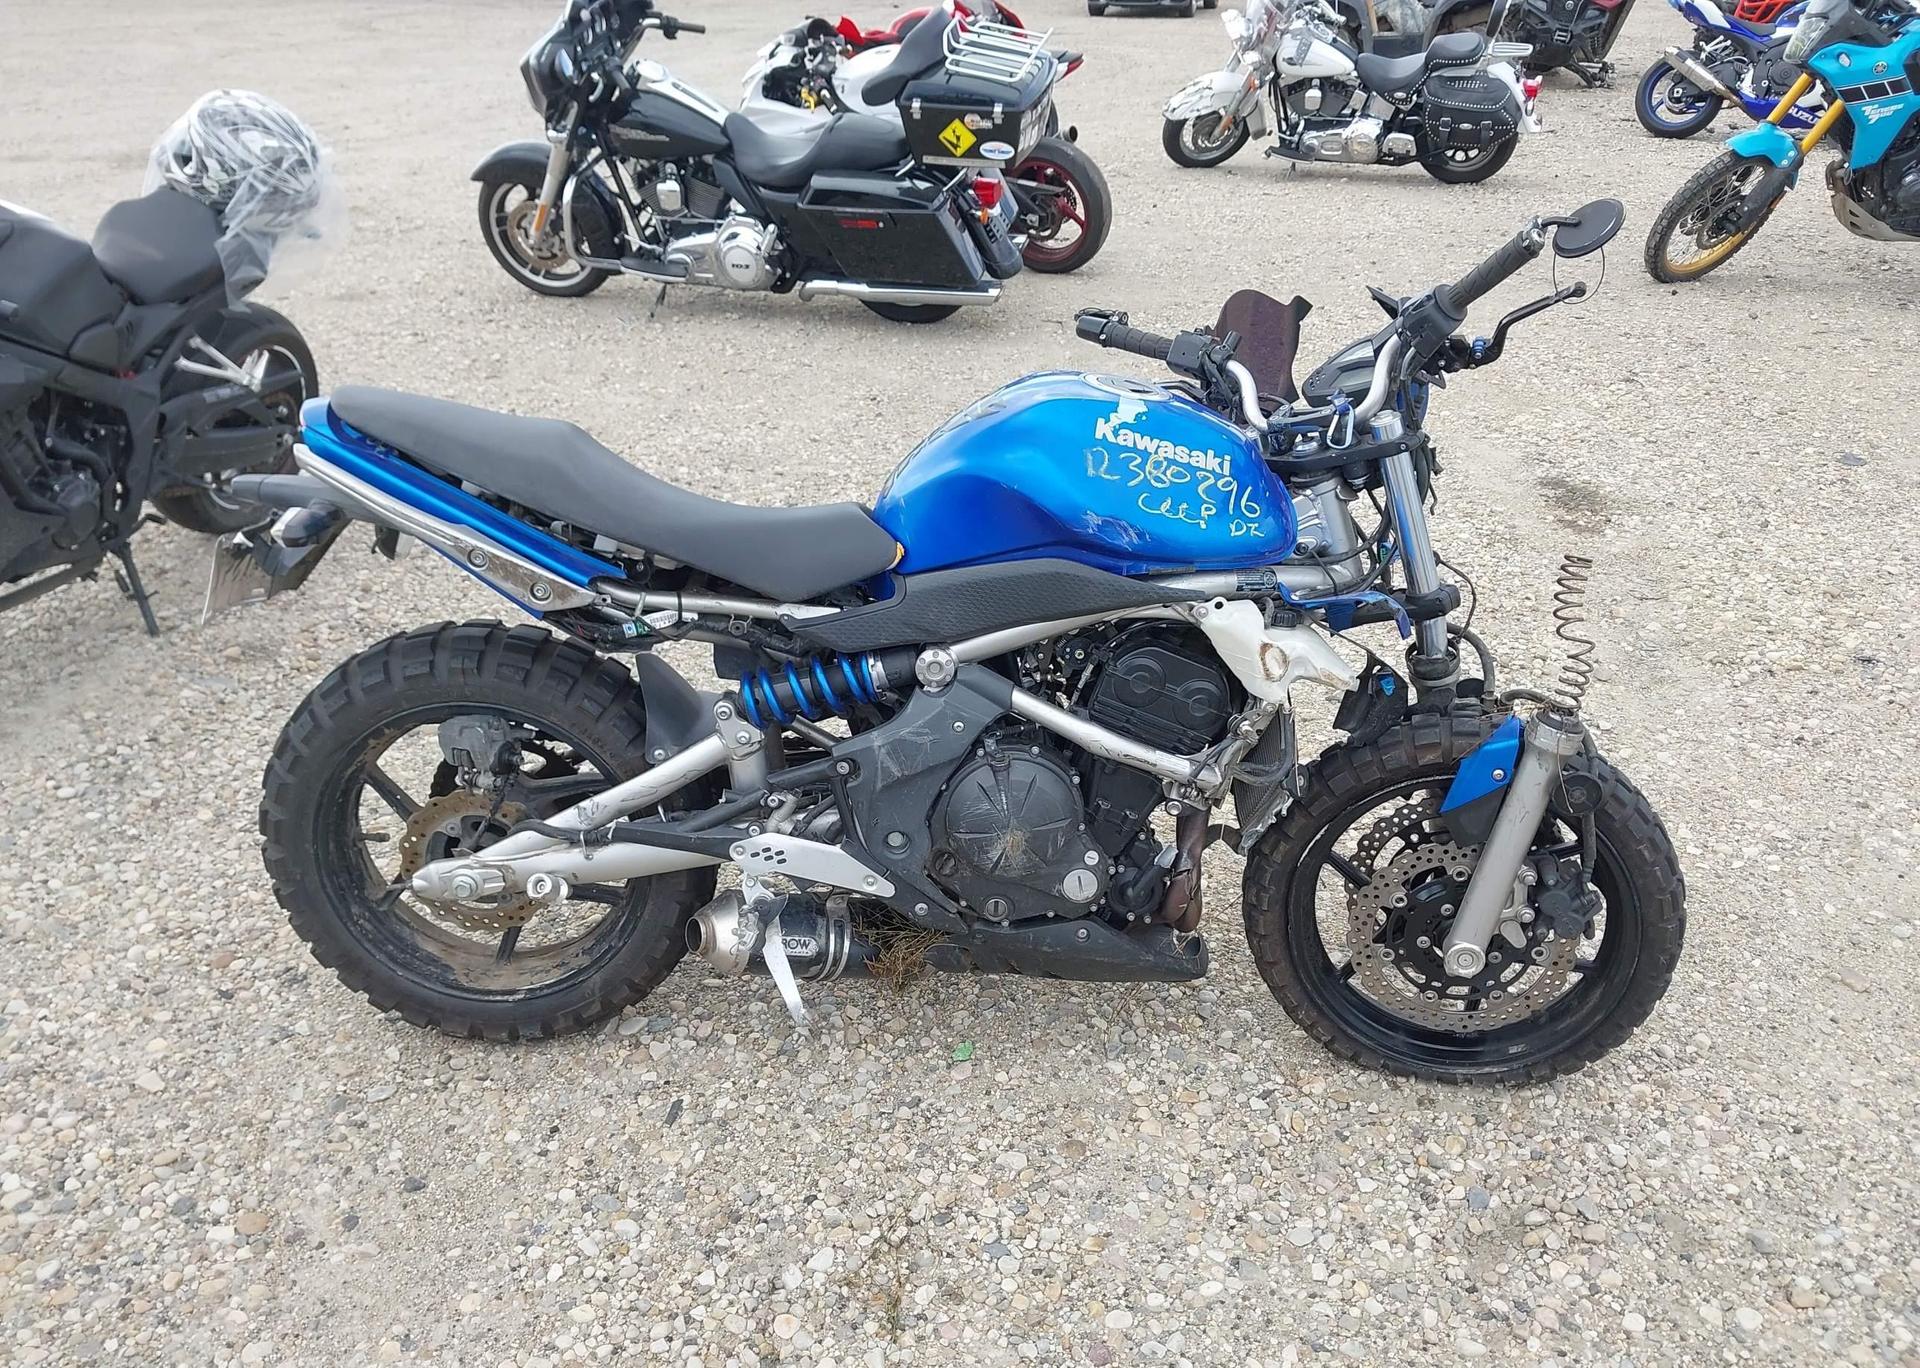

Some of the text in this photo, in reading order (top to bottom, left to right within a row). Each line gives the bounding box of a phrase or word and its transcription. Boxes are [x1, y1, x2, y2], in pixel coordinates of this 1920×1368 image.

[1787, 106, 1819, 124] UZU
[1094, 417, 1231, 476] Kawasaki
[781, 938, 811, 950] ROW
